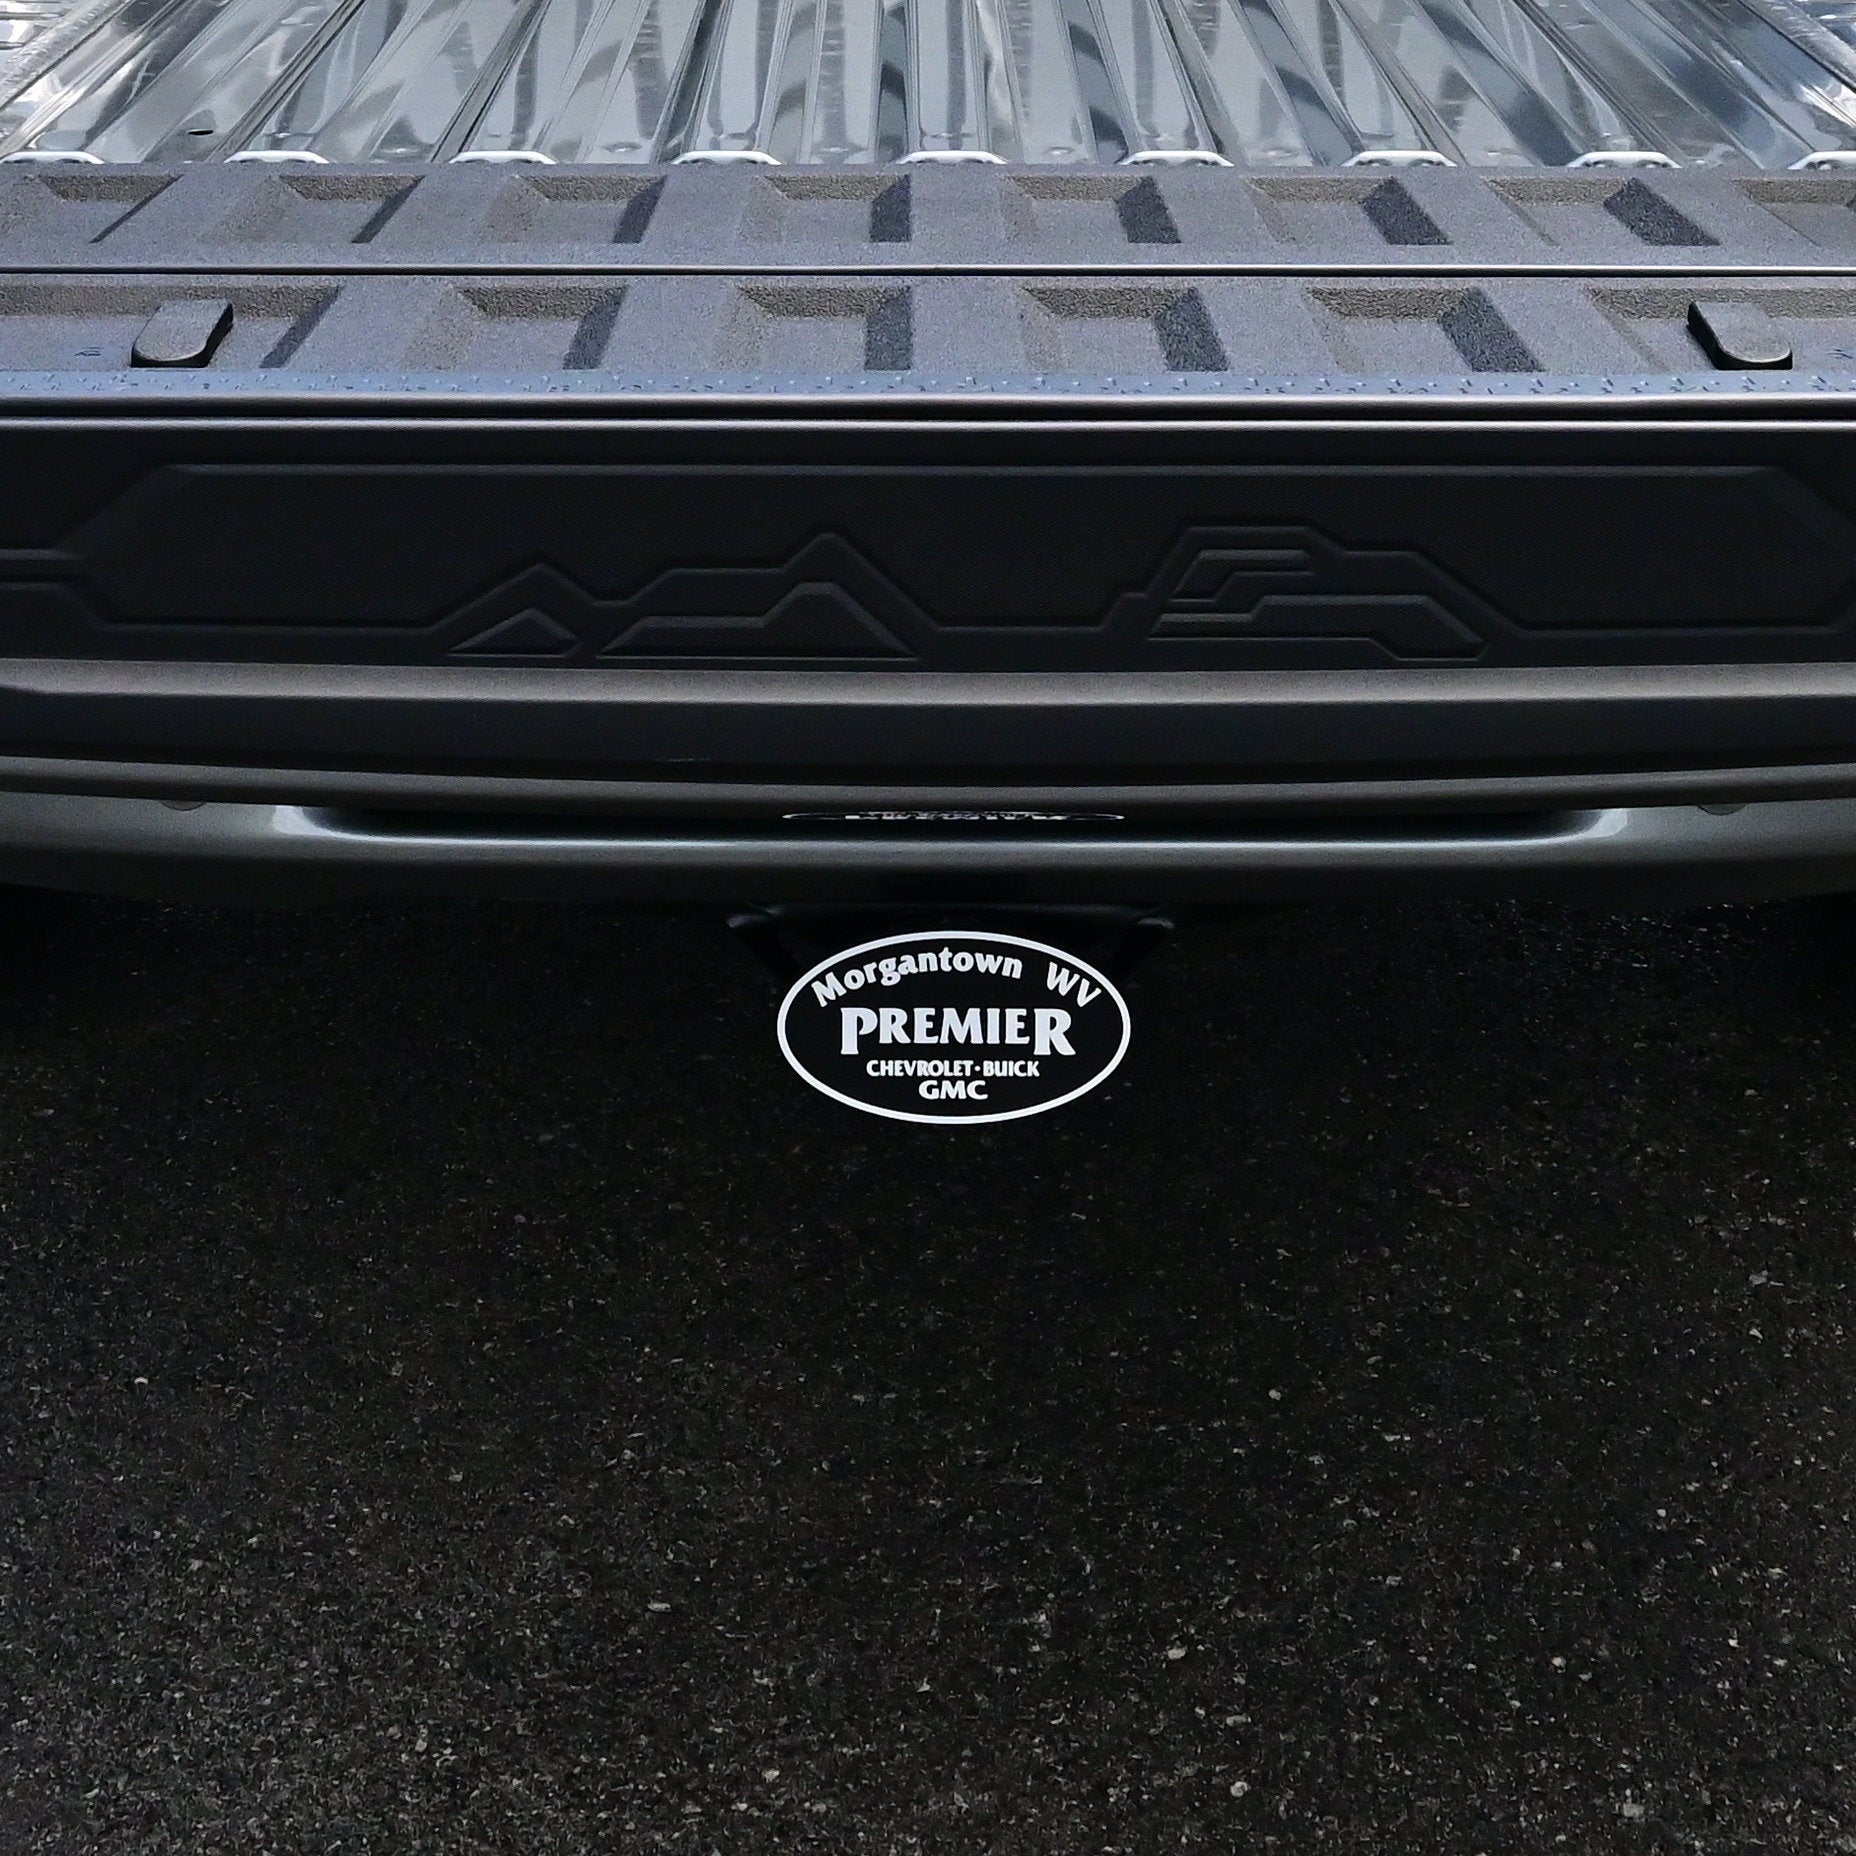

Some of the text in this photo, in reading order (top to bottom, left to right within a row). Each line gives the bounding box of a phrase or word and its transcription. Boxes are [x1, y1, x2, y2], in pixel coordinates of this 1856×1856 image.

[811, 946, 1102, 1007] Morgantown WV
[840, 1007, 1076, 1055] PREMIER
[918, 1079, 988, 1100] GMC
